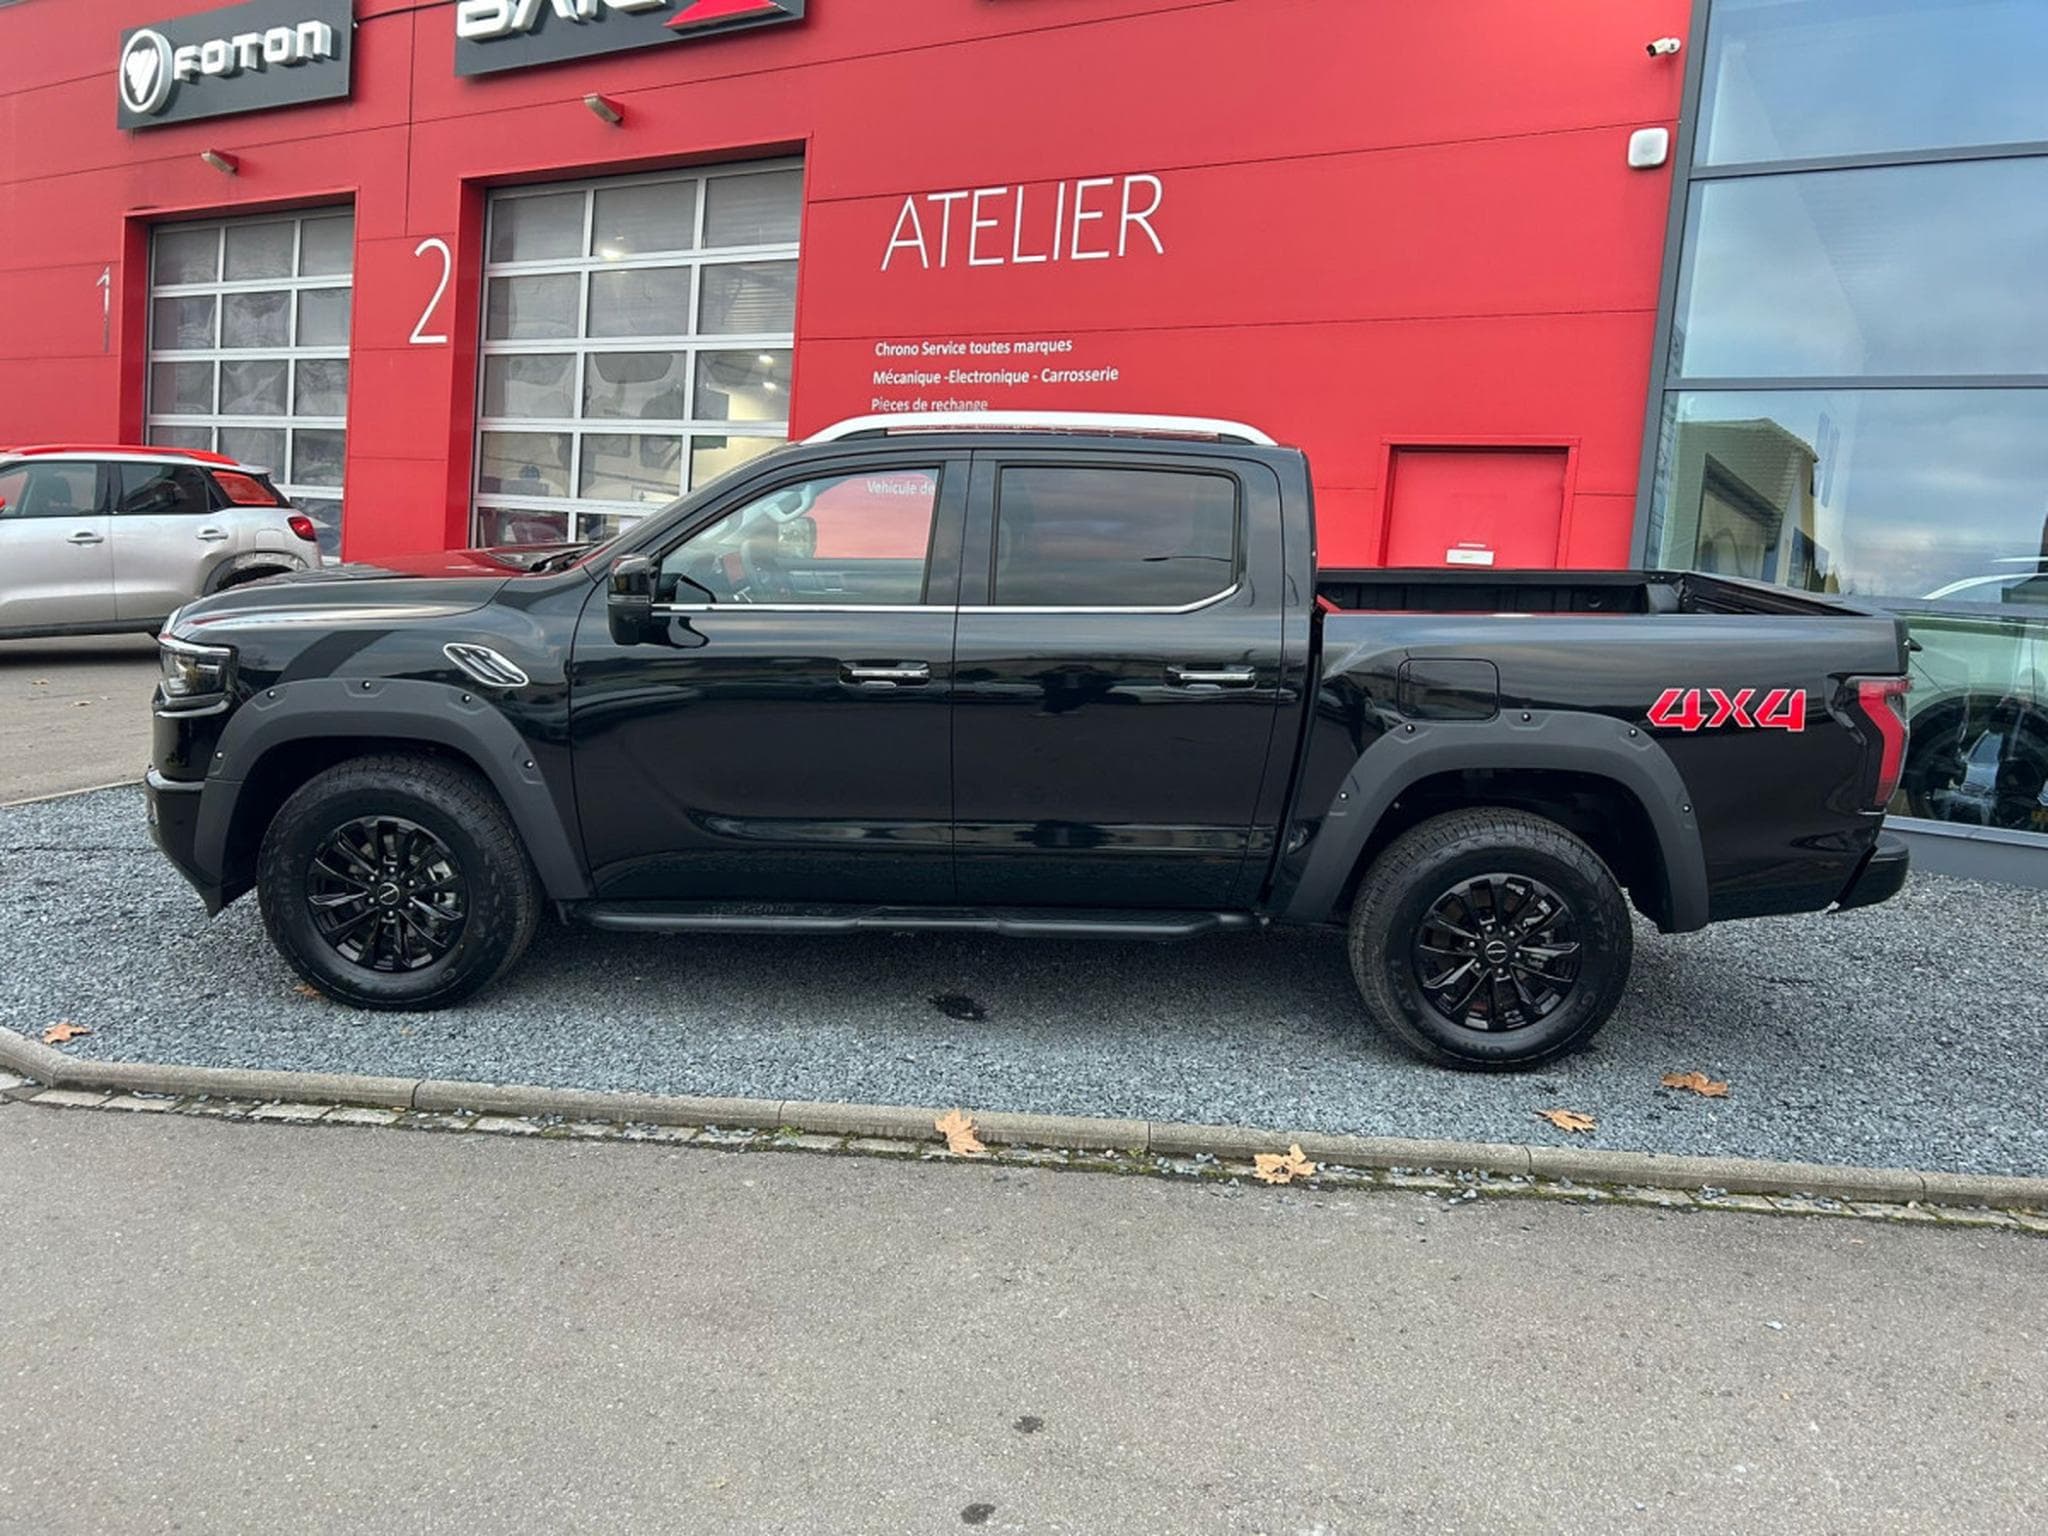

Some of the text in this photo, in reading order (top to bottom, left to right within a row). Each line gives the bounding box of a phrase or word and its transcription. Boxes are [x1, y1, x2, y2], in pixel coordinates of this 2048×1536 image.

[173, 20, 332, 80] FOTON
[881, 174, 1164, 271] ATELIER
[96, 266, 110, 352] 1
[409, 238, 451, 344] 2
[873, 368, 941, 387] Mécanique
[1041, 366, 1119, 382] Carrosserie
[875, 340, 1072, 356] Chrono Service toutes marques
[912, 397, 927, 411] de
[931, 397, 988, 411] rechange
